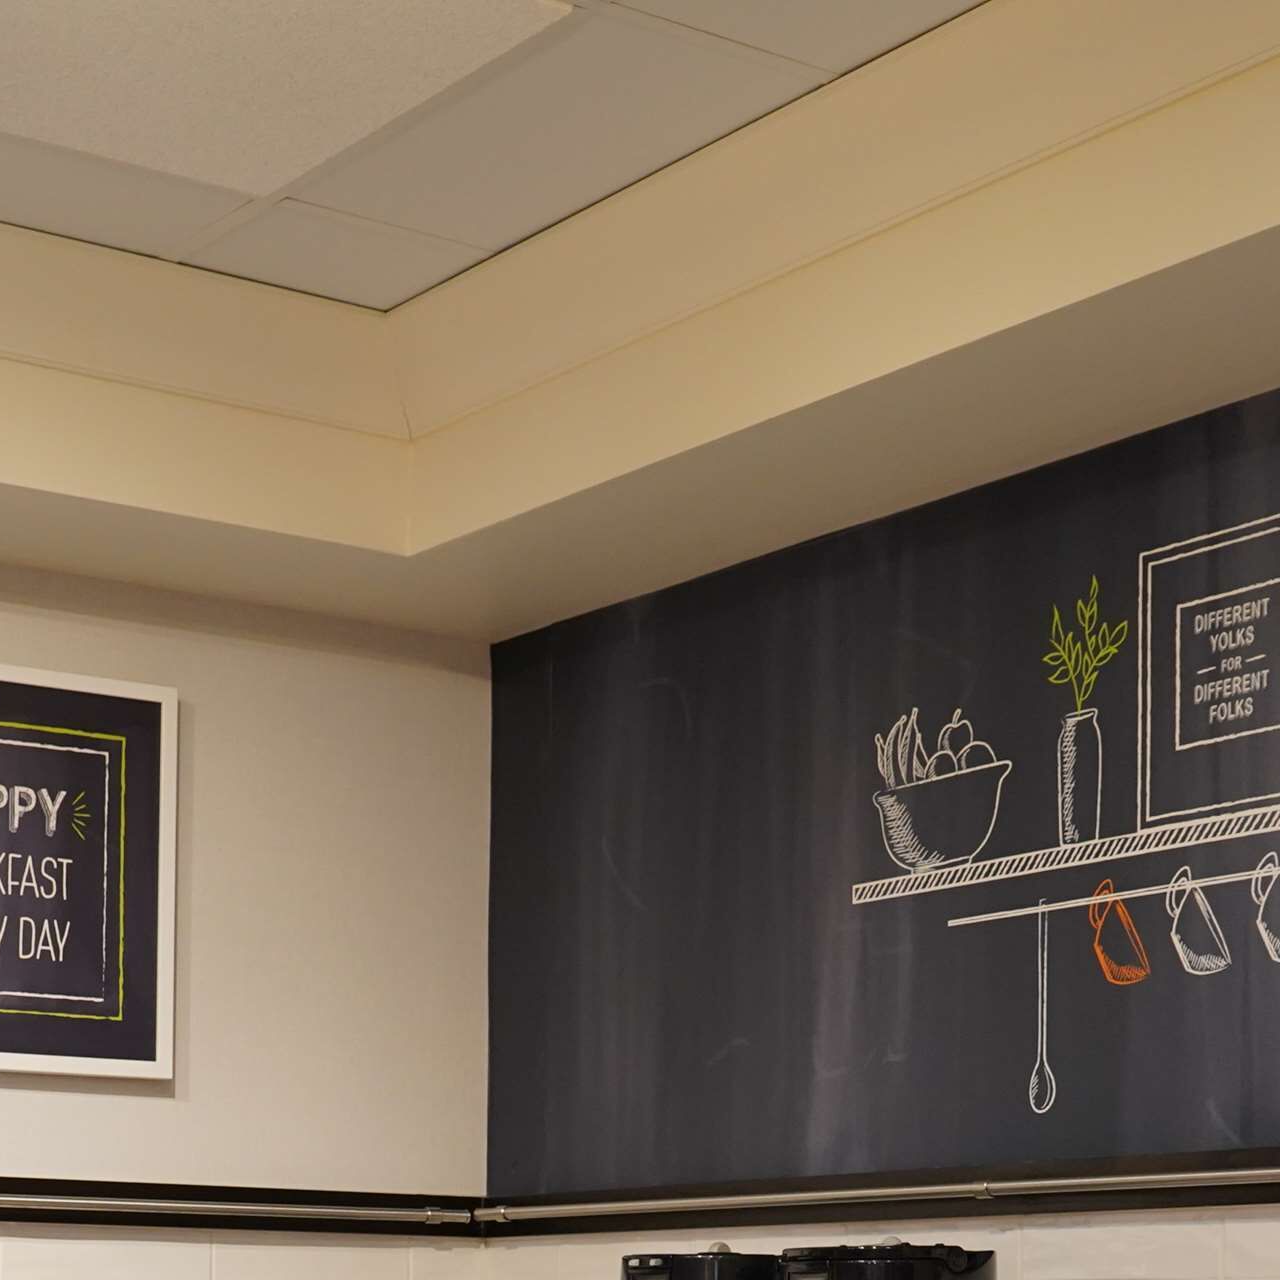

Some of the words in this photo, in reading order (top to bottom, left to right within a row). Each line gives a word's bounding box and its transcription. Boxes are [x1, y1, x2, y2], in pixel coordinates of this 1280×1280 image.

[1194, 598, 1270, 634] DIFFERENT
[1209, 625, 1255, 653] YOLKS
[1221, 656, 1242, 673] FOR
[1194, 669, 1270, 704] DIFFERENT
[1208, 697, 1254, 724] FOLKS
[19, 916, 70, 961] DAY
